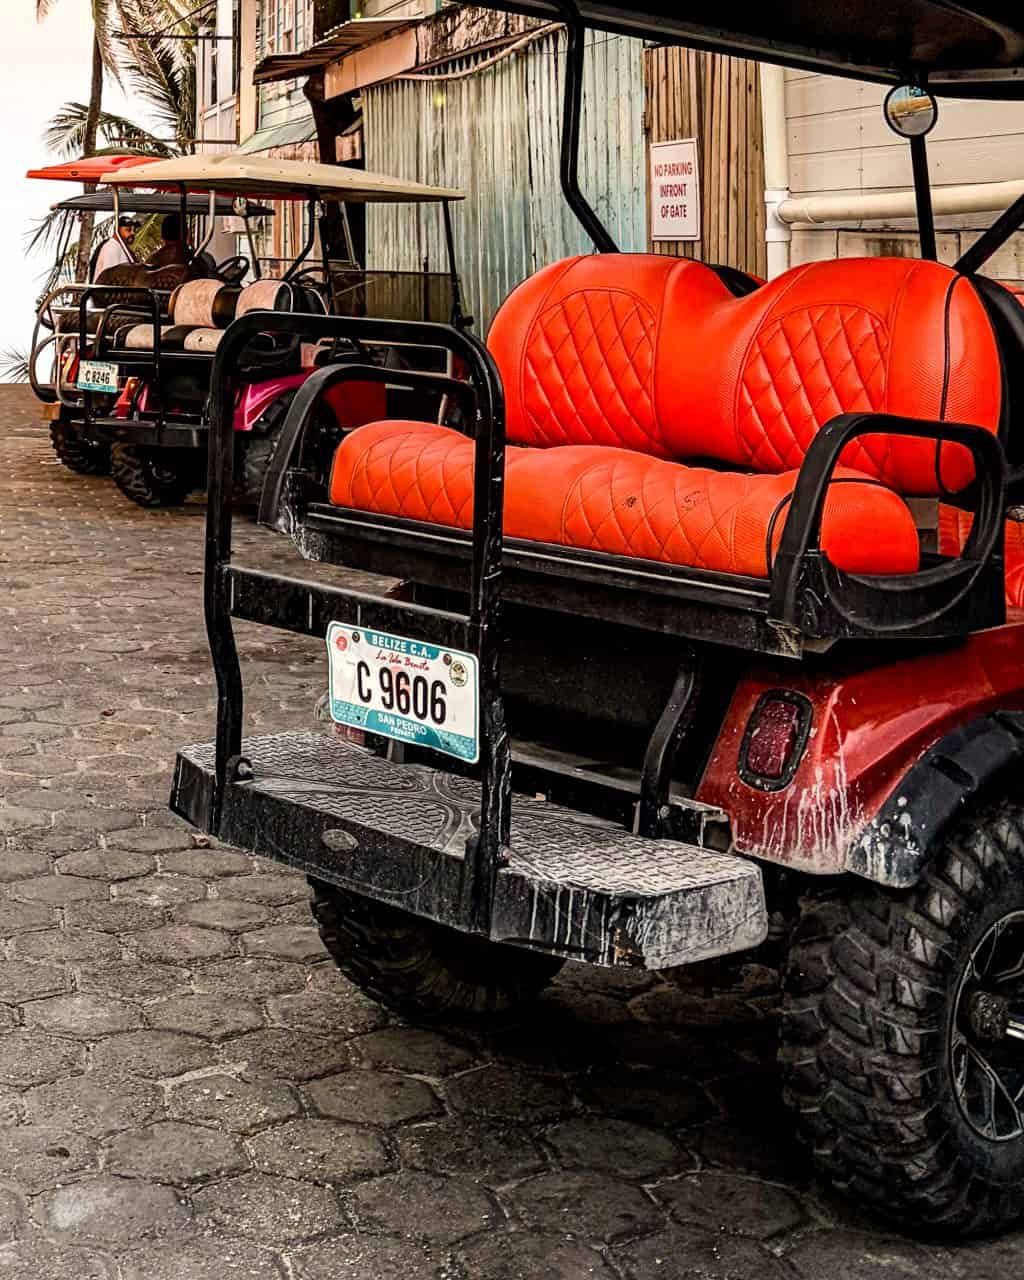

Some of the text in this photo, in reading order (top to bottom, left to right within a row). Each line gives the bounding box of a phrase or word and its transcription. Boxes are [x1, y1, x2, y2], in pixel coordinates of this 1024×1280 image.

[655, 162, 693, 177] NO PARKING
[660, 184, 687, 197] INFRONT
[661, 205, 687, 218] OF GATE
[85, 370, 111, 384] C 8246
[372, 635, 432, 658] BELIZE C.A.
[356, 661, 448, 725] C 9606
[377, 713, 427, 736] SAN PEDRO
